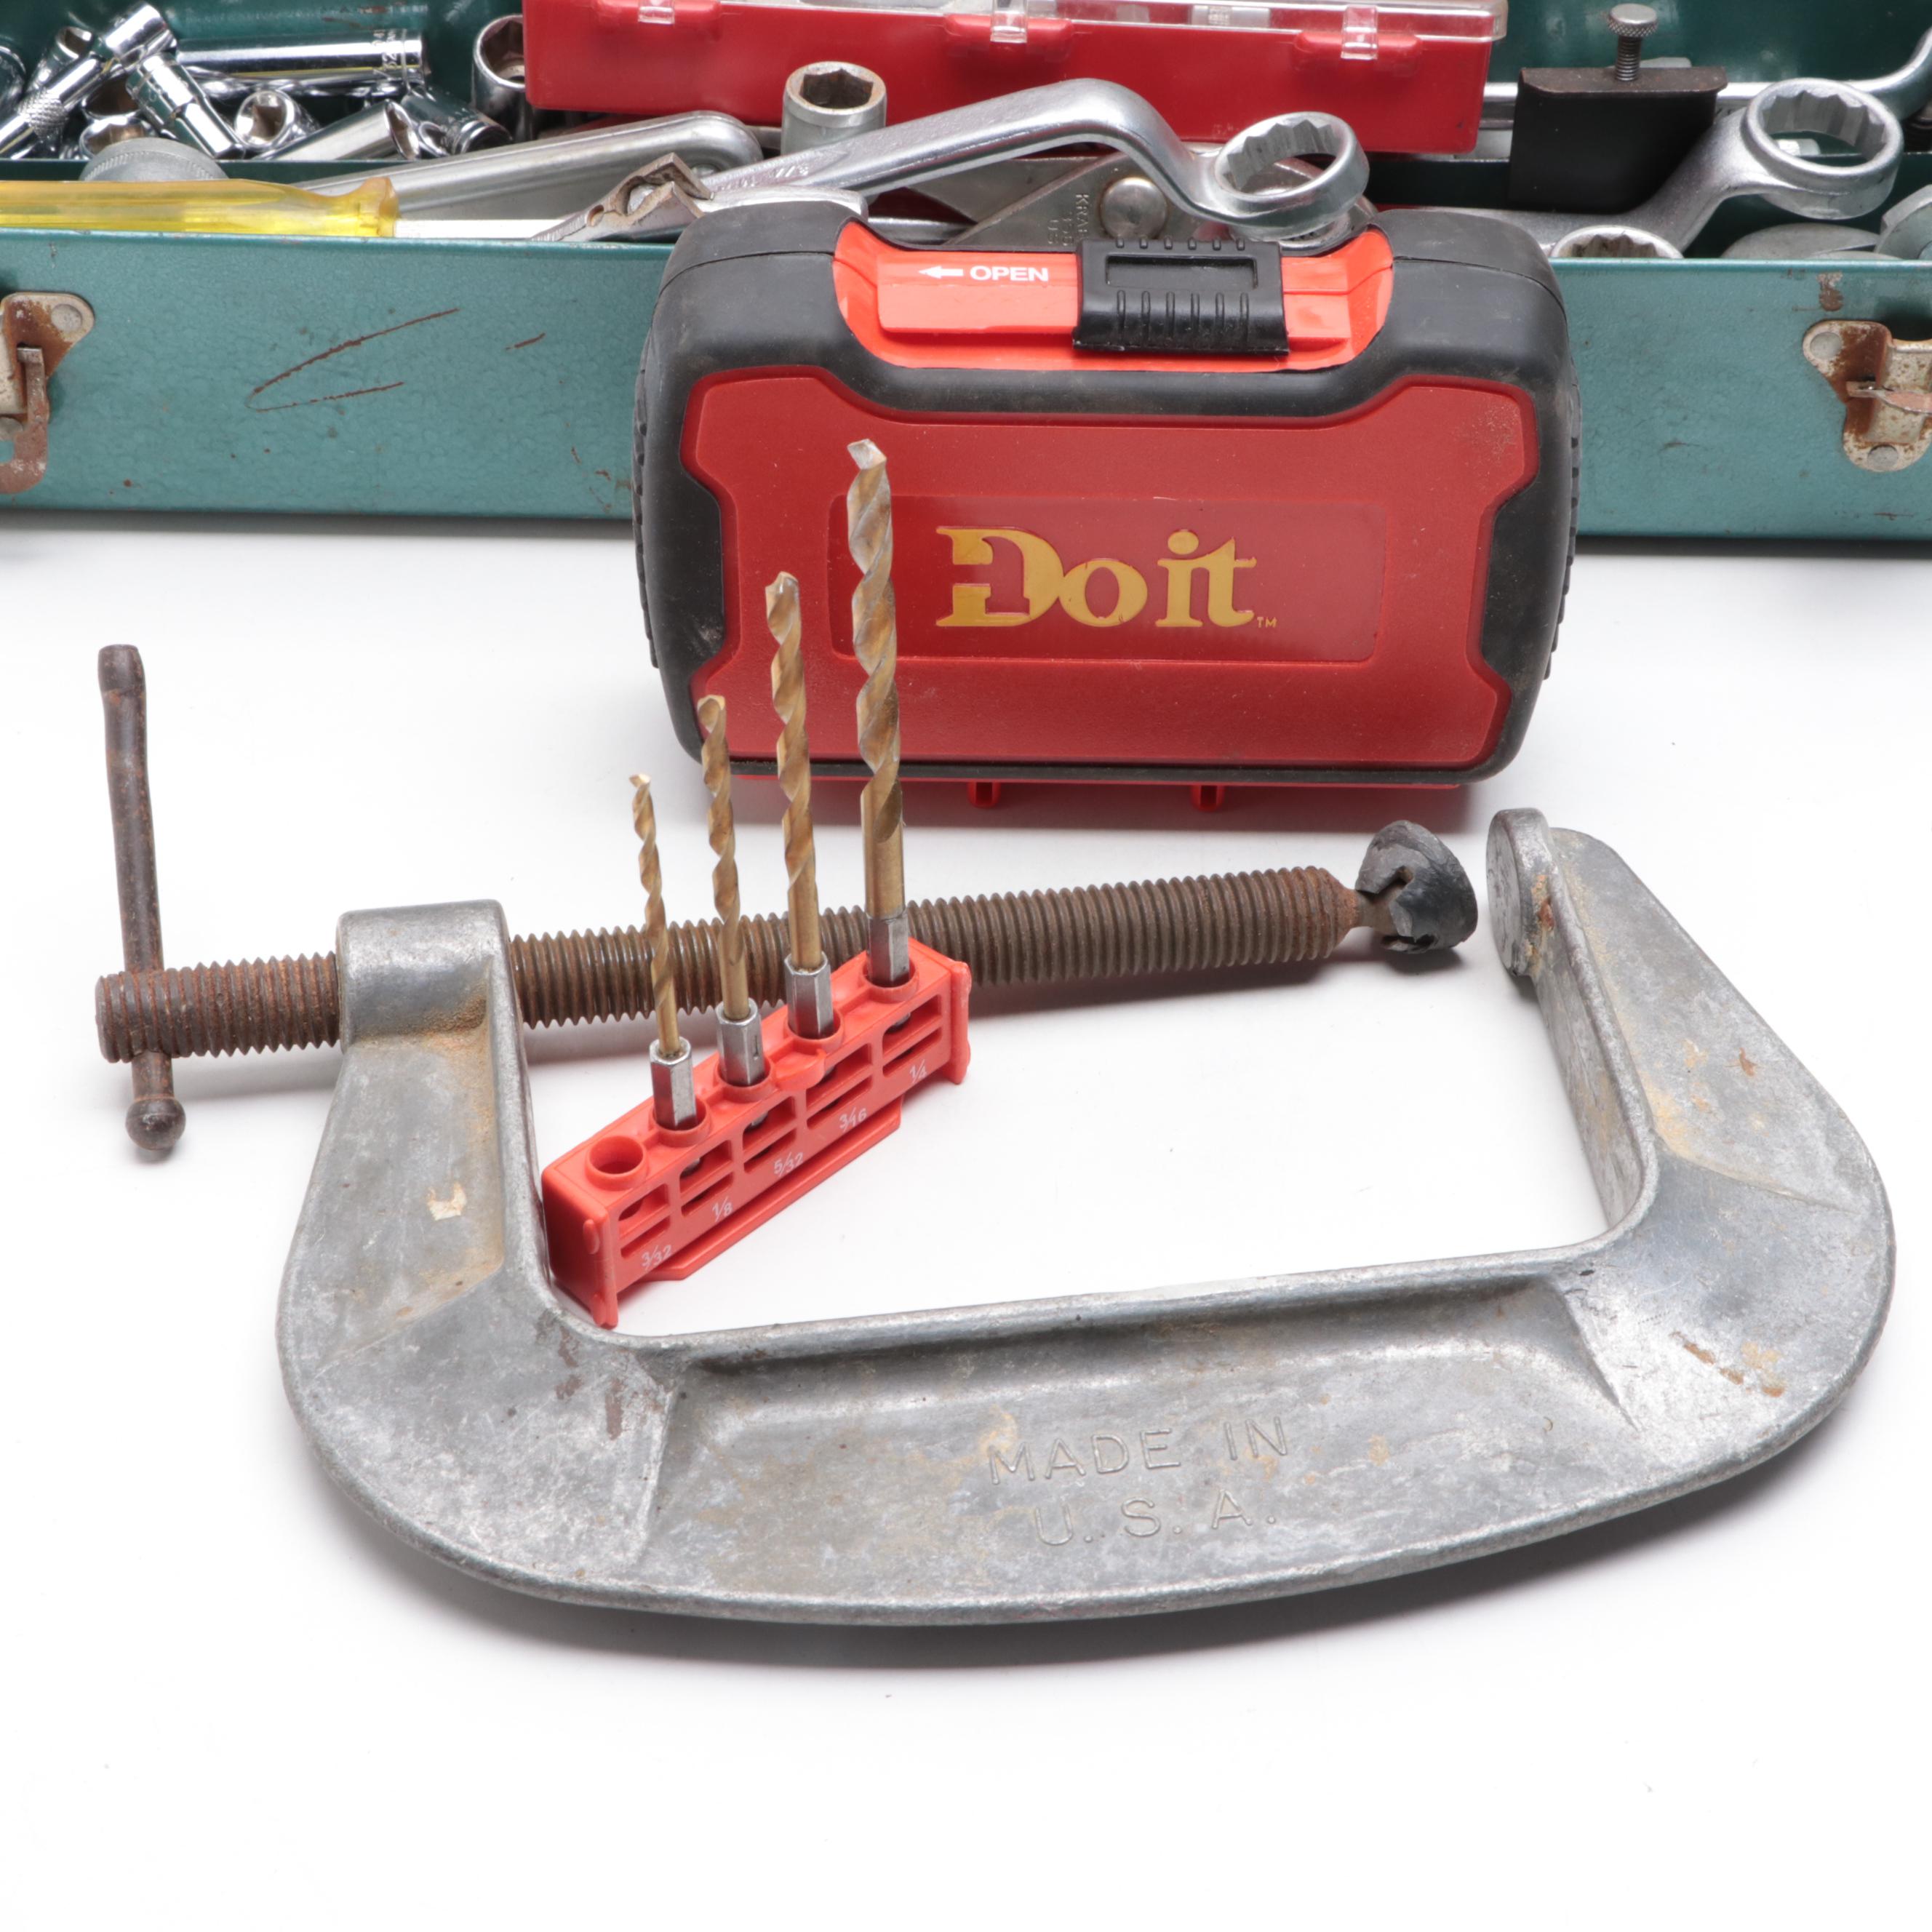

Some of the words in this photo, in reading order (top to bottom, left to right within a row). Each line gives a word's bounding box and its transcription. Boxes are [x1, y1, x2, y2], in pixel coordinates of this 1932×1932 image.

[970, 265, 1049, 282] OPEN
[935, 526, 1148, 627] Do
[1155, 529, 1257, 628] it
[909, 1059, 928, 1084] 1/4
[839, 1106, 868, 1132] 3/16
[773, 1151, 804, 1177] 5/32
[712, 1196, 733, 1223] 1/8
[642, 1245, 672, 1272] 3/32
[988, 1427, 1181, 1485] MADE
[1224, 1416, 1289, 1461] IN
